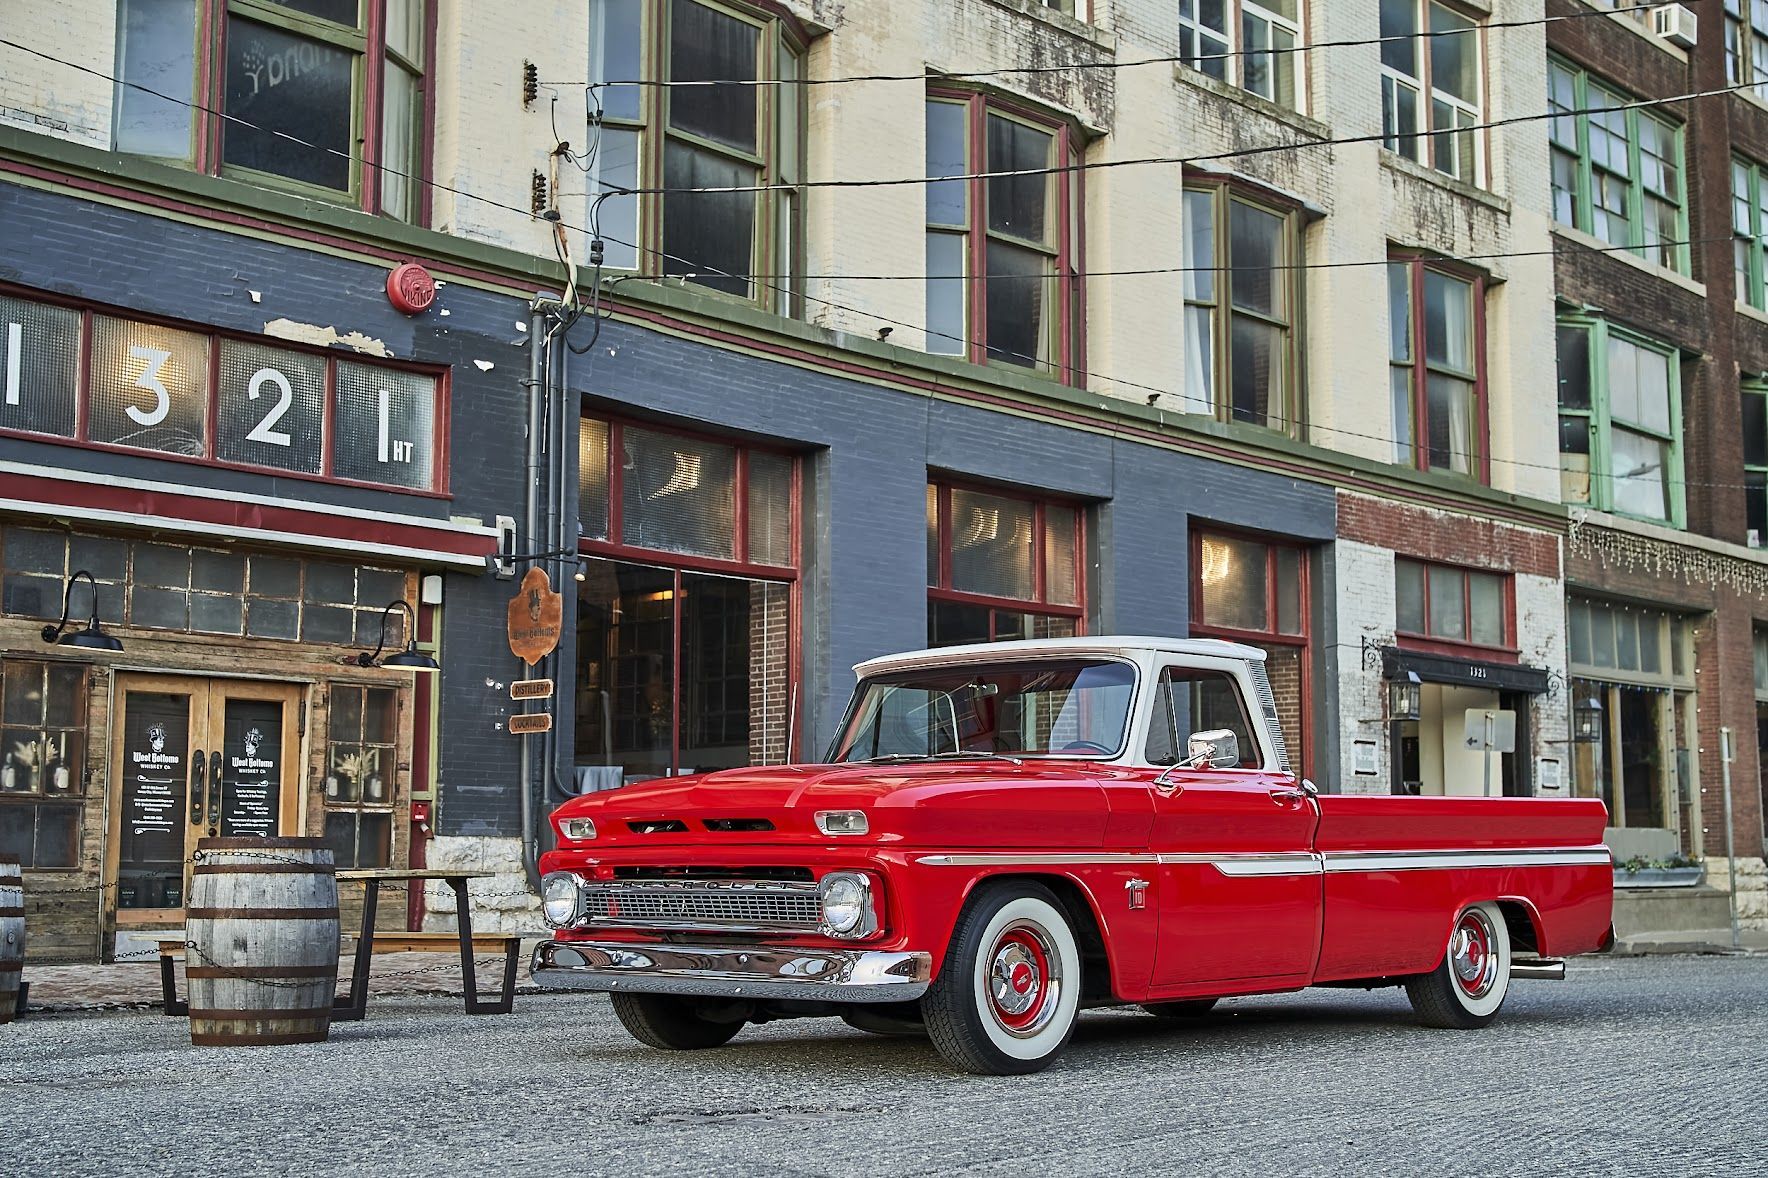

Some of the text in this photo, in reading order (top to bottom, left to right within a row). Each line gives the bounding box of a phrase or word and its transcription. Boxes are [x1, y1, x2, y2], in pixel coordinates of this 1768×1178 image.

[393, 440, 414, 463] HT
[515, 684, 550, 695] DISTILLERY
[133, 751, 179, 763] West Bottoms
[231, 756, 274, 768] West Bottoms
[602, 881, 794, 891] CHEVROLET
